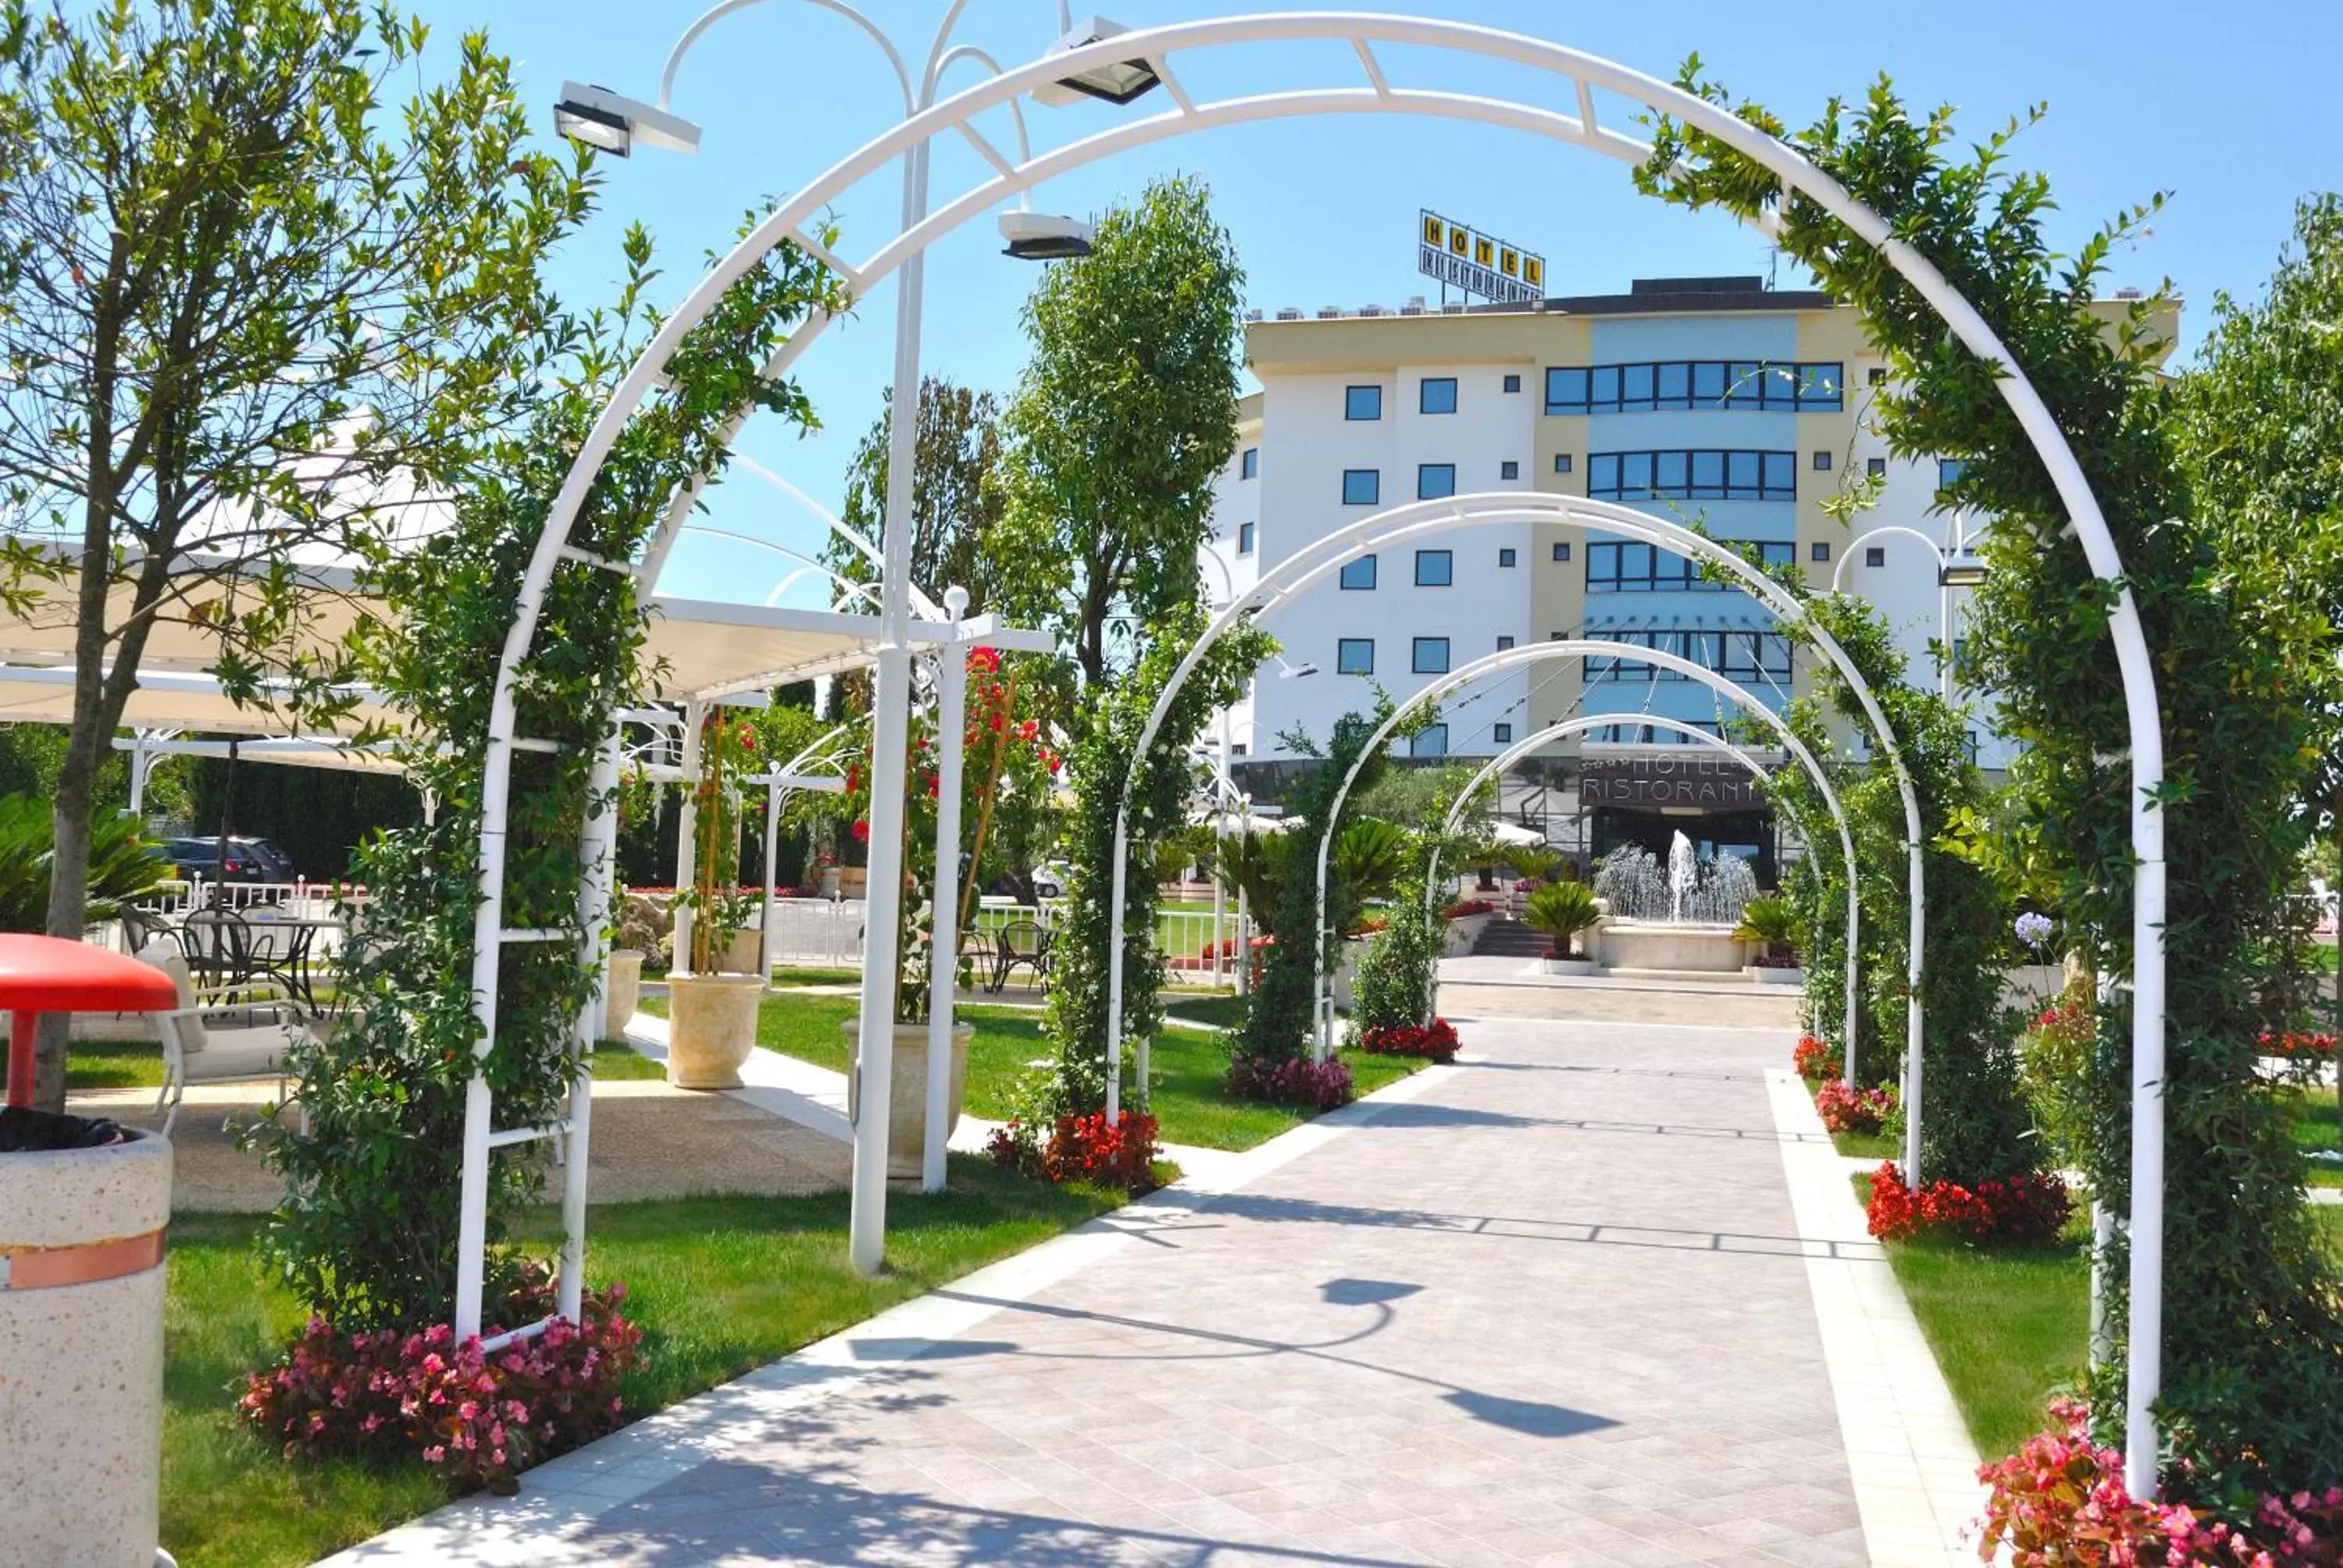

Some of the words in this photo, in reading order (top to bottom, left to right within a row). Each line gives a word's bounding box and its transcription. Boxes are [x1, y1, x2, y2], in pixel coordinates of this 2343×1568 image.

[1428, 219, 1538, 282] HOTEL
[1632, 753, 1730, 775] HOTEL
[1583, 779, 1756, 801] RISTORANT
